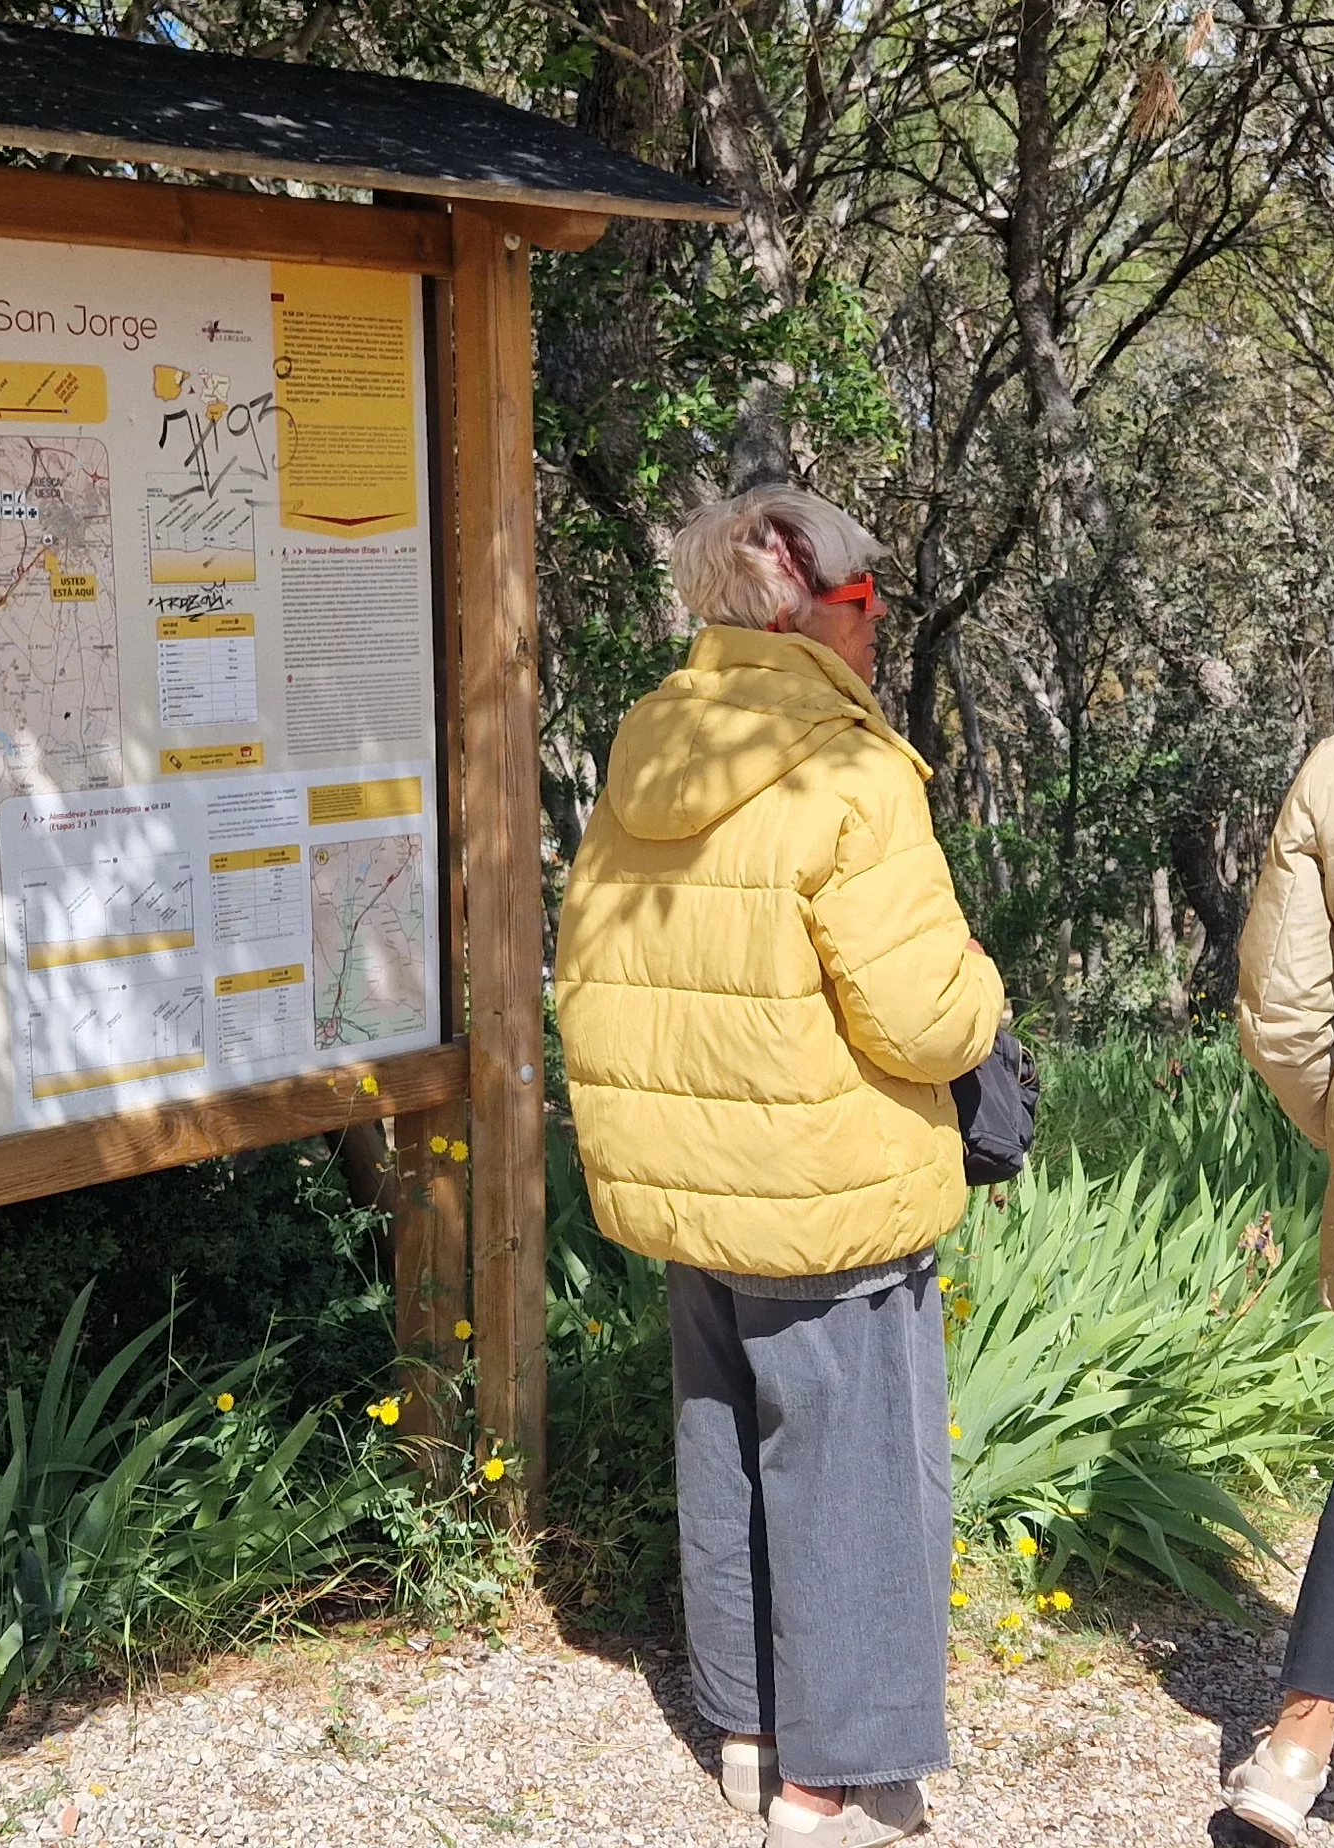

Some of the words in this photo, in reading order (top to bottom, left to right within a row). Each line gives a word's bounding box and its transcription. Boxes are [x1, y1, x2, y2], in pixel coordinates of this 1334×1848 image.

[66, 304, 158, 351] Jorge
[60, 577, 86, 586] USTED
[53, 586, 74, 597] ESTÁ
[74, 585, 95, 597] AQUÍ
